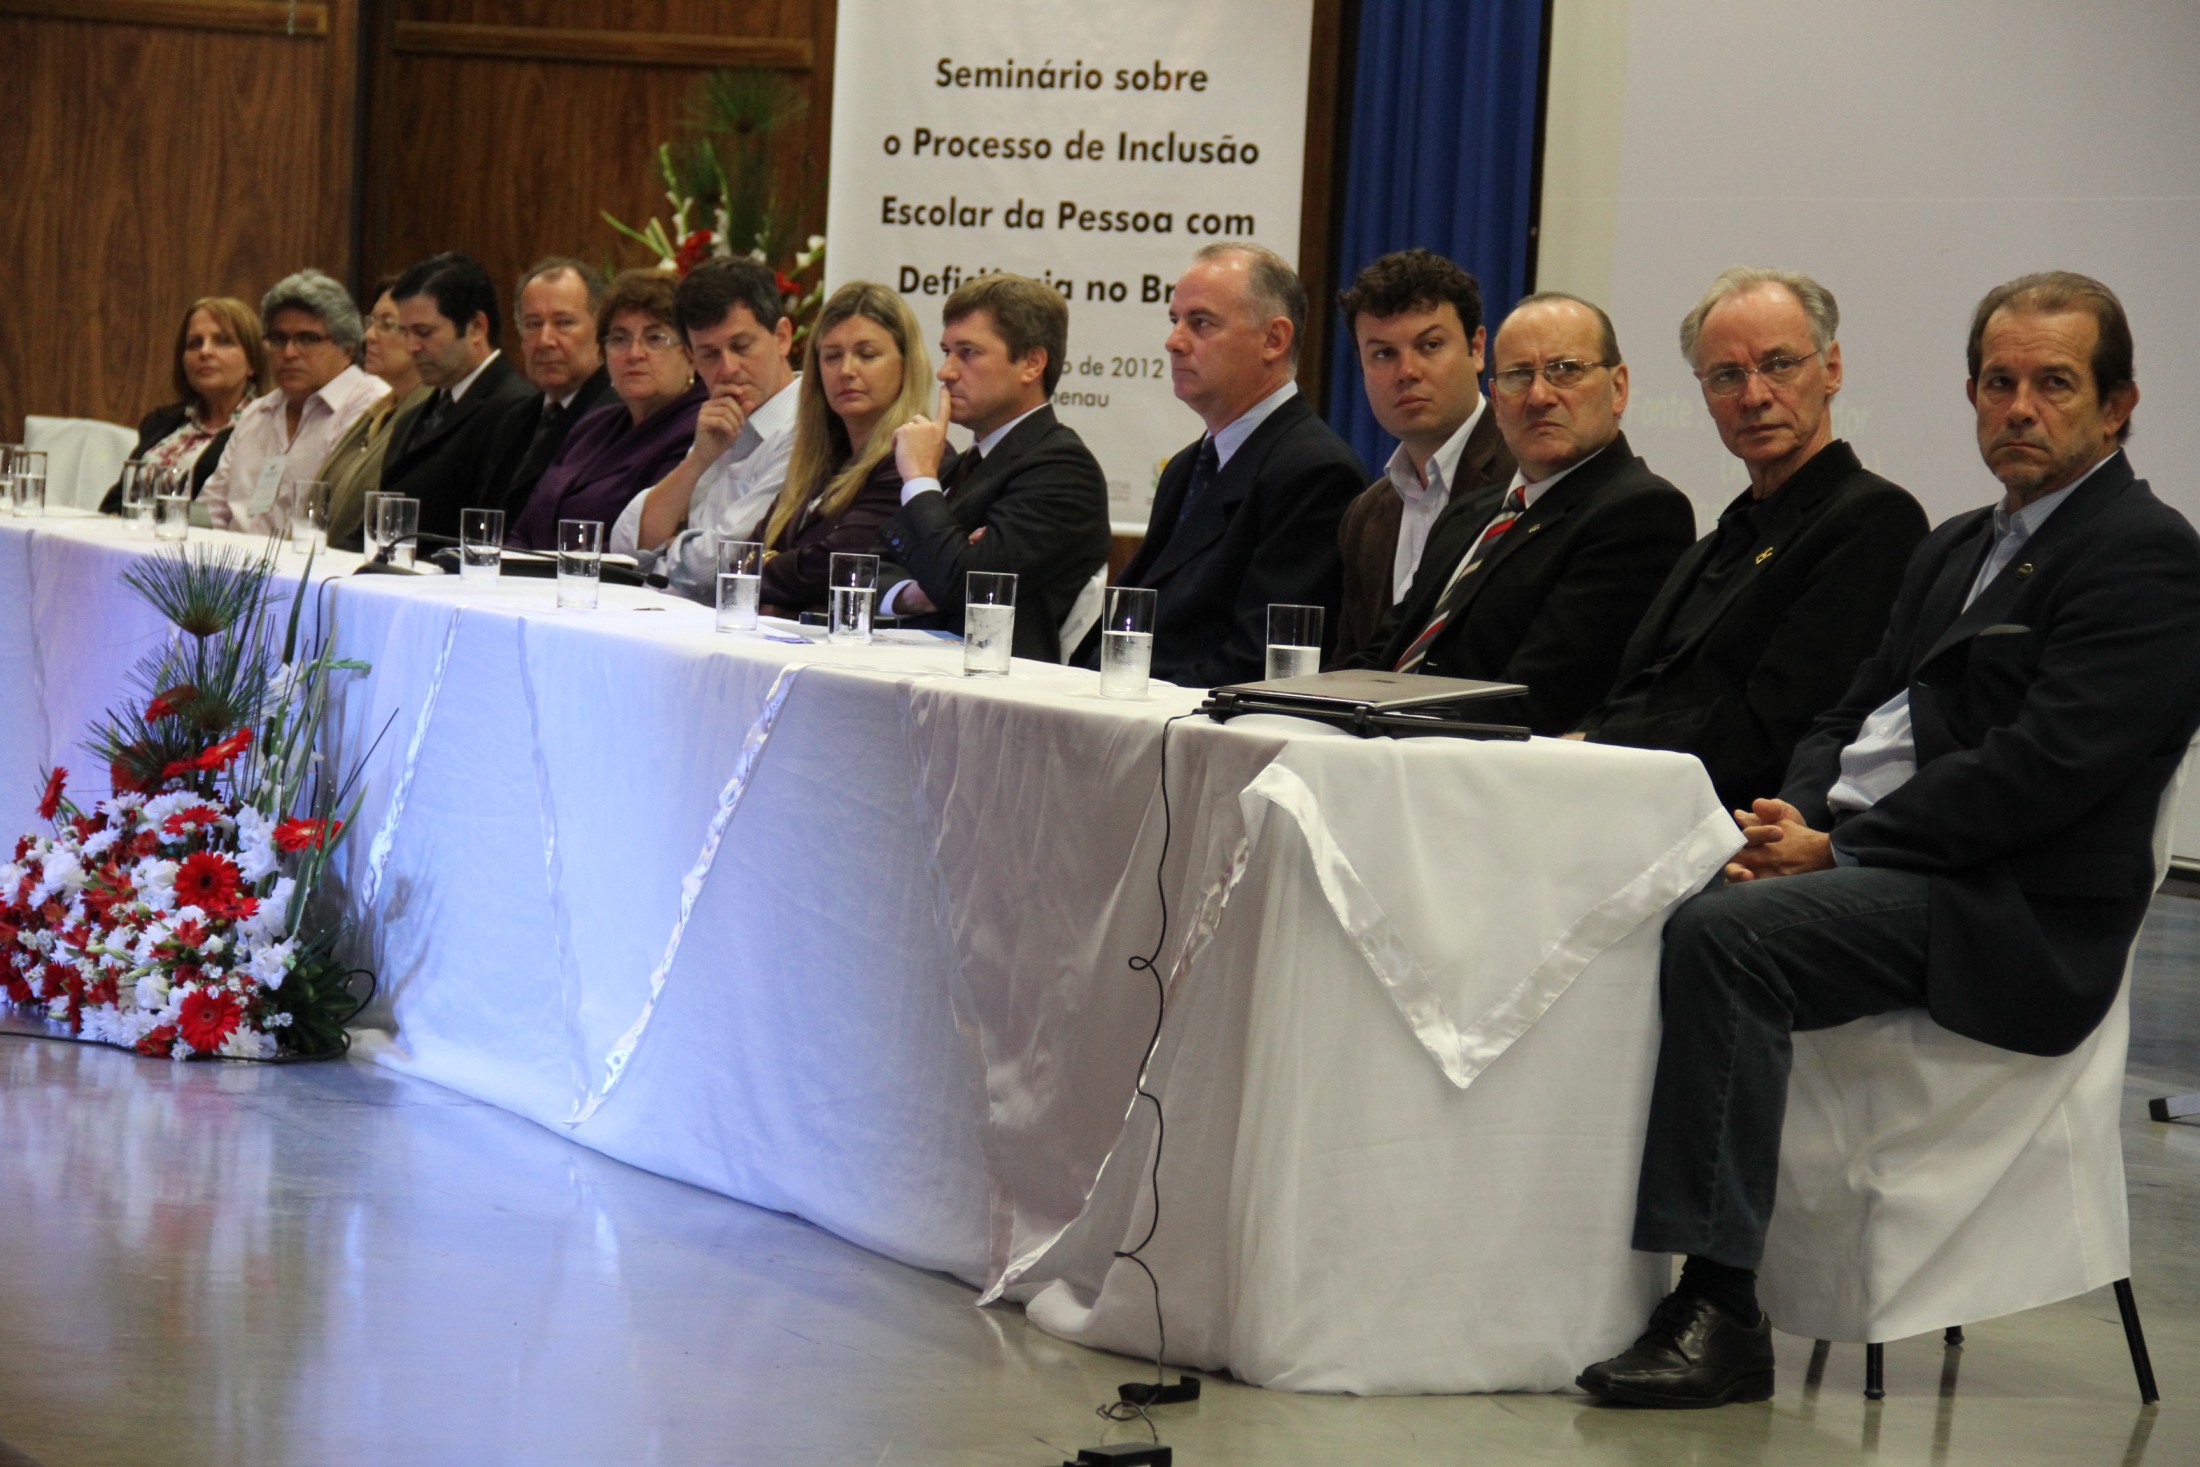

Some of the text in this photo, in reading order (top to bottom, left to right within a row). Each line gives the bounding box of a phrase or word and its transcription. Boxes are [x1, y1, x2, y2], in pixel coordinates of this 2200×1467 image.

[935, 57, 1209, 93] Seminário sobre
[883, 127, 1260, 165] o Processo de Inclusão
[881, 195, 1255, 236] Escolar da Pessoa com
[1086, 280, 1128, 303] no
[1079, 354, 1104, 376] de
[1111, 356, 1164, 378] 2012
[1053, 391, 1109, 407] enau
